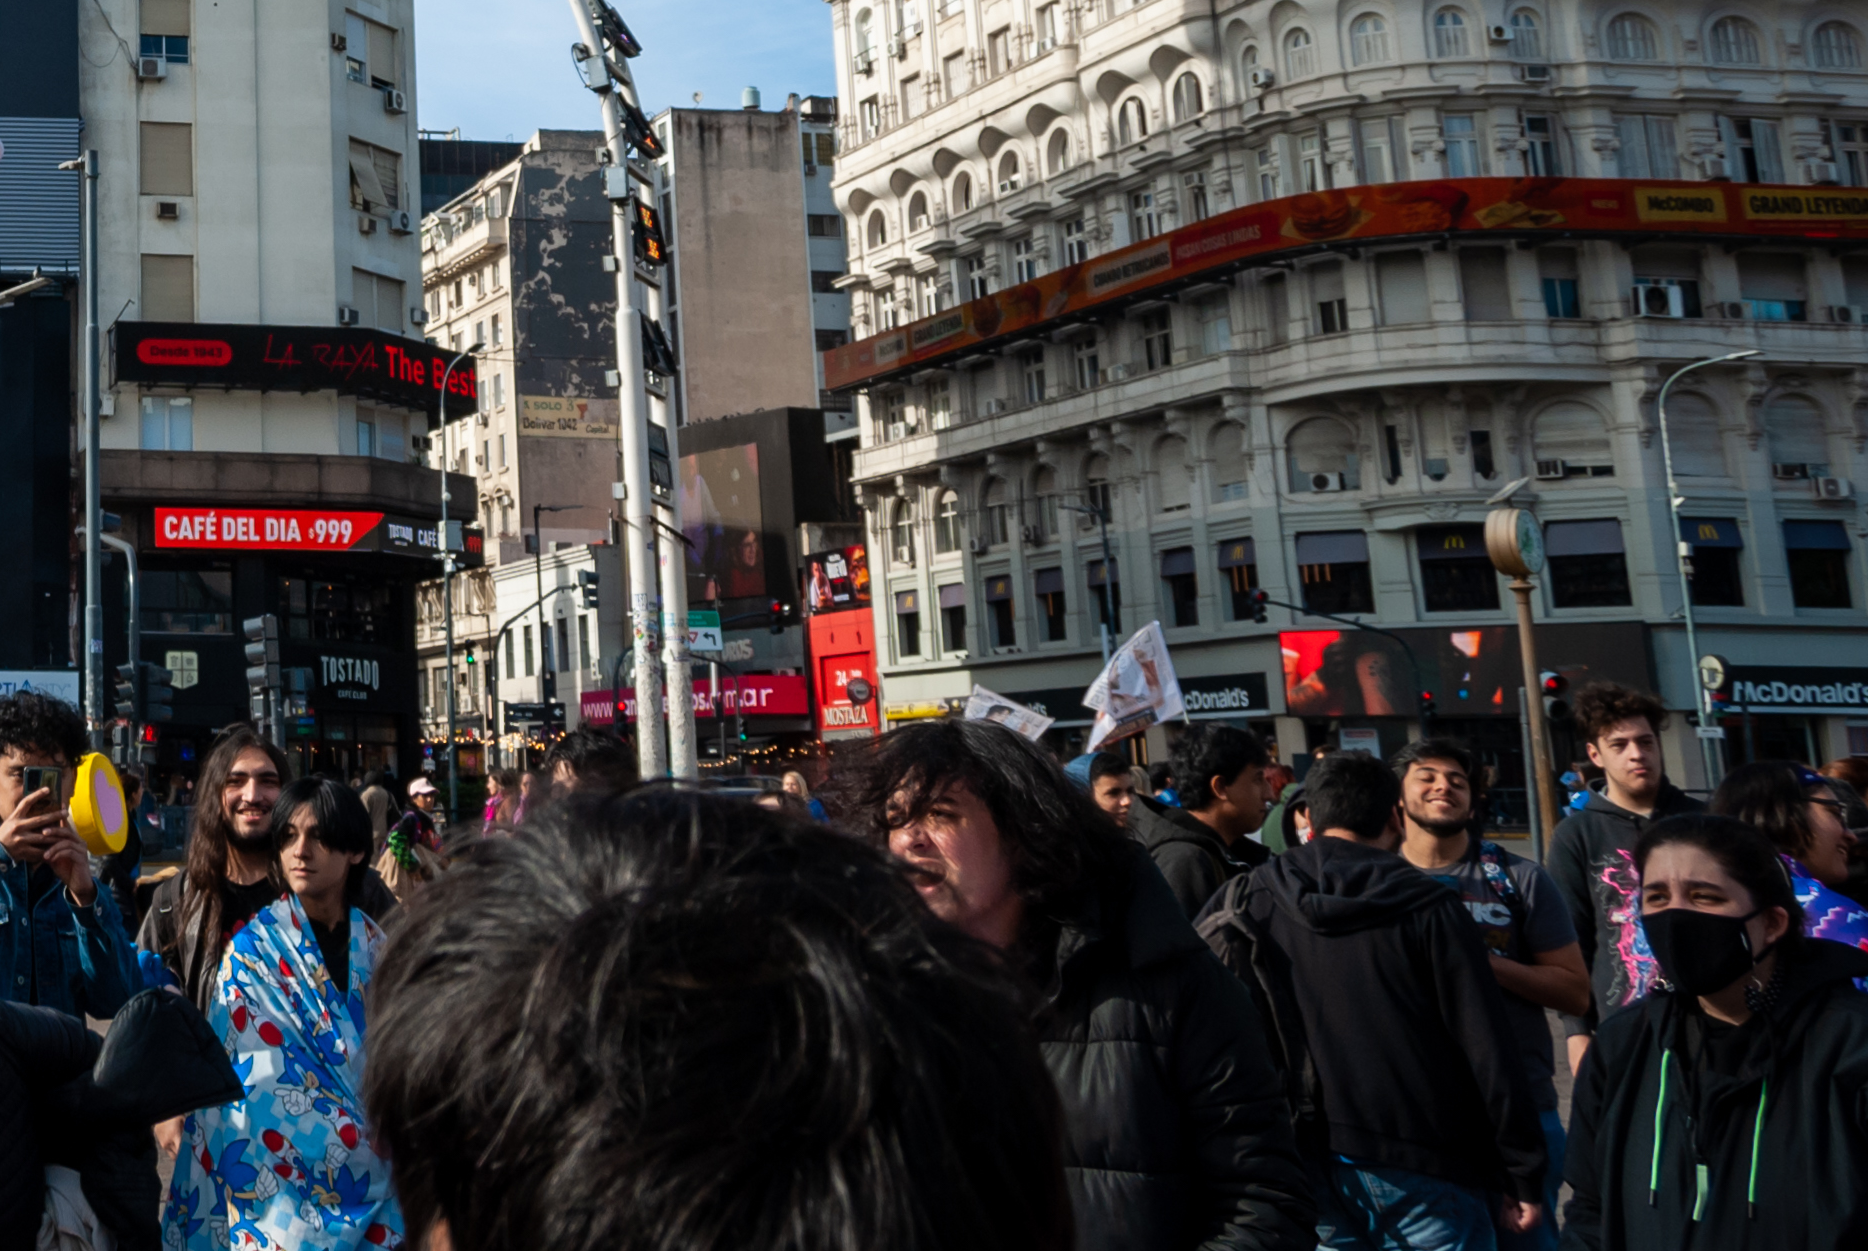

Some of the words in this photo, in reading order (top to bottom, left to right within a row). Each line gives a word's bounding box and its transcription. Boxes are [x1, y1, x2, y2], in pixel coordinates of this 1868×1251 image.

[1647, 195, 1714, 213] McCOMBO
[1749, 195, 1803, 214] GRAND
[264, 333, 303, 371] LA
[312, 340, 380, 381] RAYA
[384, 345, 426, 387] The
[534, 401, 562, 411] SOLO
[164, 511, 218, 541] CAFÉ
[222, 516, 260, 542] DEL
[265, 517, 302, 543] DIA
[308, 520, 352, 544] $999
[388, 523, 414, 543] TOSTADO
[418, 526, 437, 548] CAFÉ
[320, 655, 380, 691] TOSTADO
[1185, 686, 1249, 711] cDonald's
[824, 705, 869, 726] MOSTAZA
